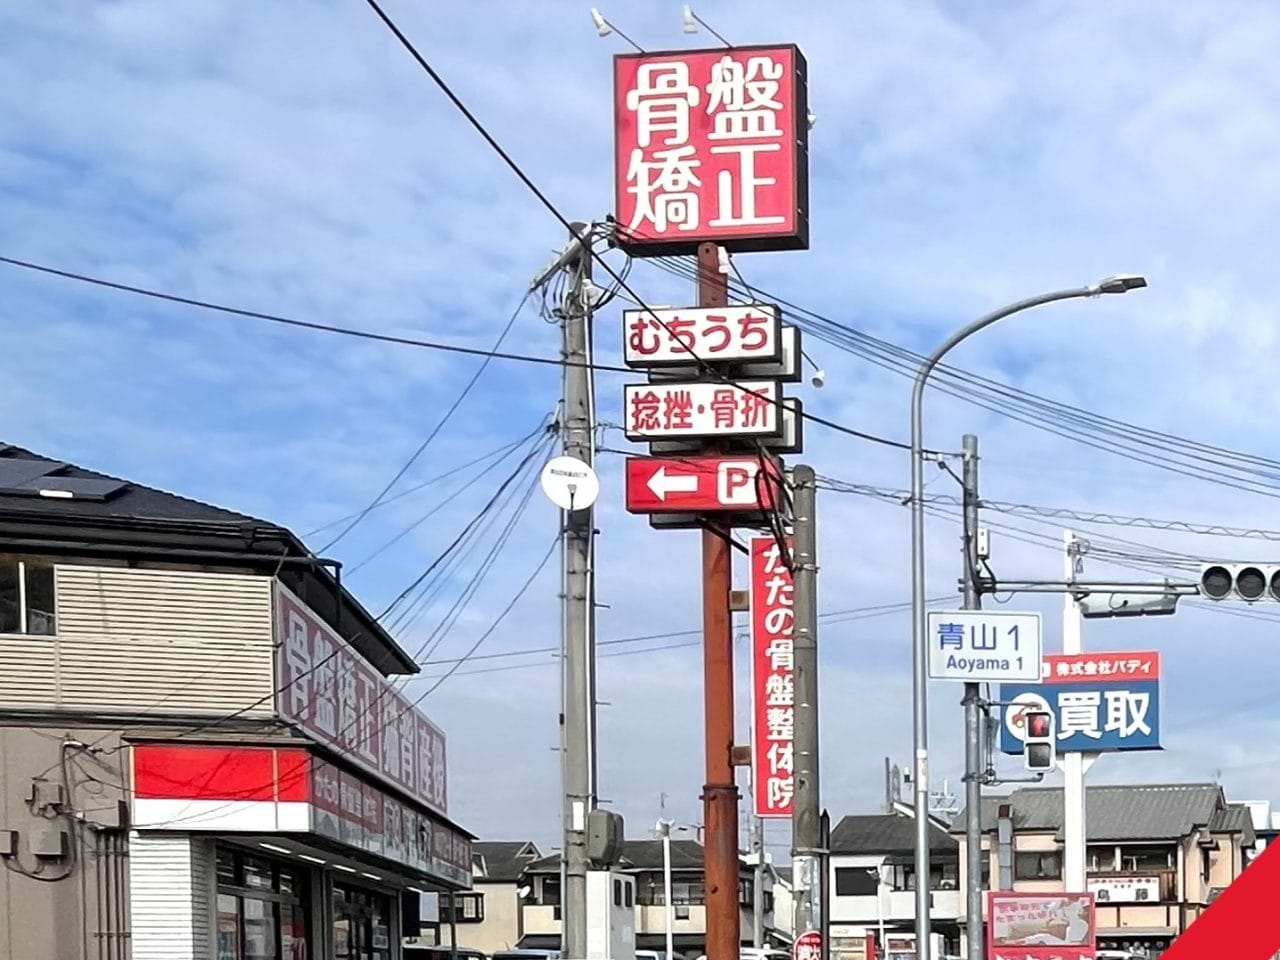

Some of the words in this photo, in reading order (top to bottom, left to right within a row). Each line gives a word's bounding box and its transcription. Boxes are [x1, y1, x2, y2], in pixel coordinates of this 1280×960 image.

[627, 55, 784, 147] 骨盤
[626, 145, 786, 233] 矯正
[629, 313, 768, 355] むちうち
[726, 468, 749, 498] P
[946, 655, 1010, 673] Aoyama
[1015, 656, 1023, 671] 1
[1056, 659, 1152, 677] 株式会社バディ
[1057, 690, 1152, 740] 買取
